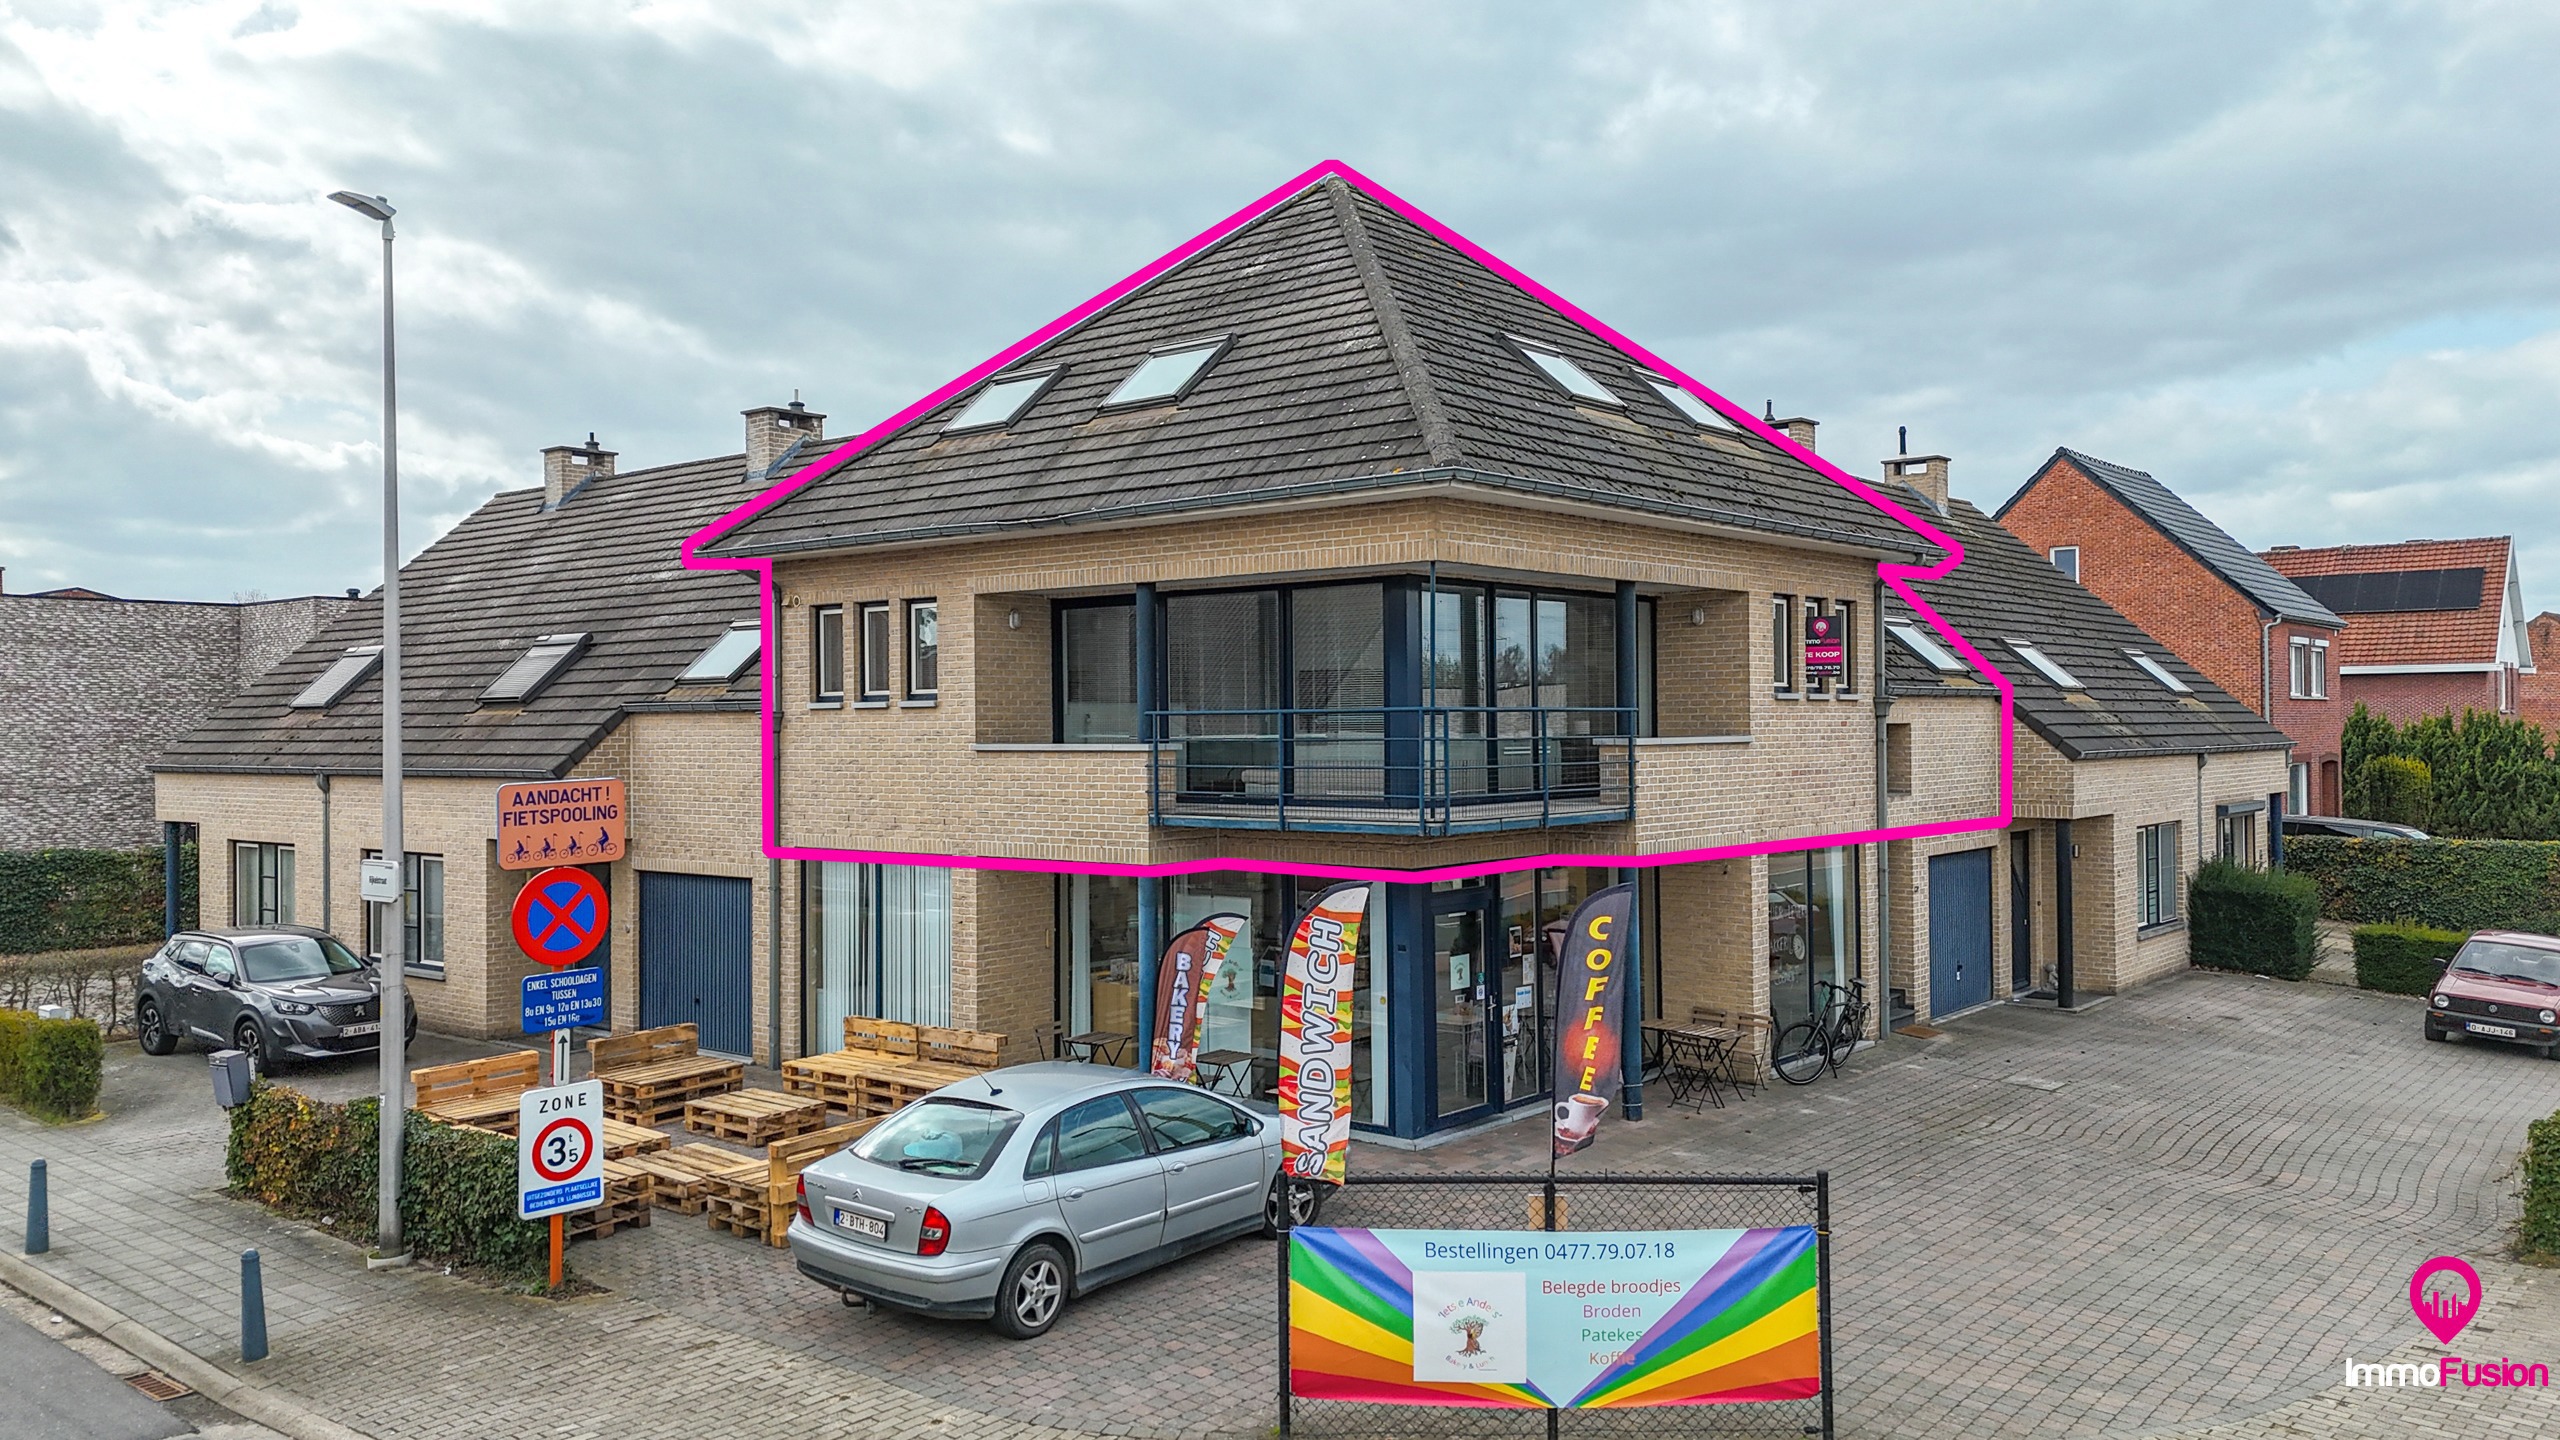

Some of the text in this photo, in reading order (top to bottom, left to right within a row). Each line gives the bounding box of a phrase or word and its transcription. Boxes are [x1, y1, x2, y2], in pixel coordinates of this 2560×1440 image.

[512, 786, 610, 807] AANDACHT !
[503, 804, 618, 828] FIETSPOOLING
[526, 972, 597, 992] ENKEL SCHOOLDAGEN
[551, 988, 577, 1001] TUSSEN
[1579, 915, 1613, 1092] COFFEE
[524, 996, 602, 1017] 8u EN 9u 12u EN 13u30
[1166, 951, 1193, 1060] BAKERY
[544, 1016, 557, 1027] 15u
[557, 1014, 567, 1026] EN
[1296, 916, 1343, 1177] SANDWICH
[538, 1091, 587, 1114] ZONE
[1425, 1241, 1675, 1264] Bestellingen 0477.79.07.18
[1542, 1279, 1681, 1298] Belegde broodjes
[1583, 1304, 1641, 1319] Broden
[1582, 1328, 1643, 1342] Patekes
[1589, 1351, 1636, 1366] Koffie
